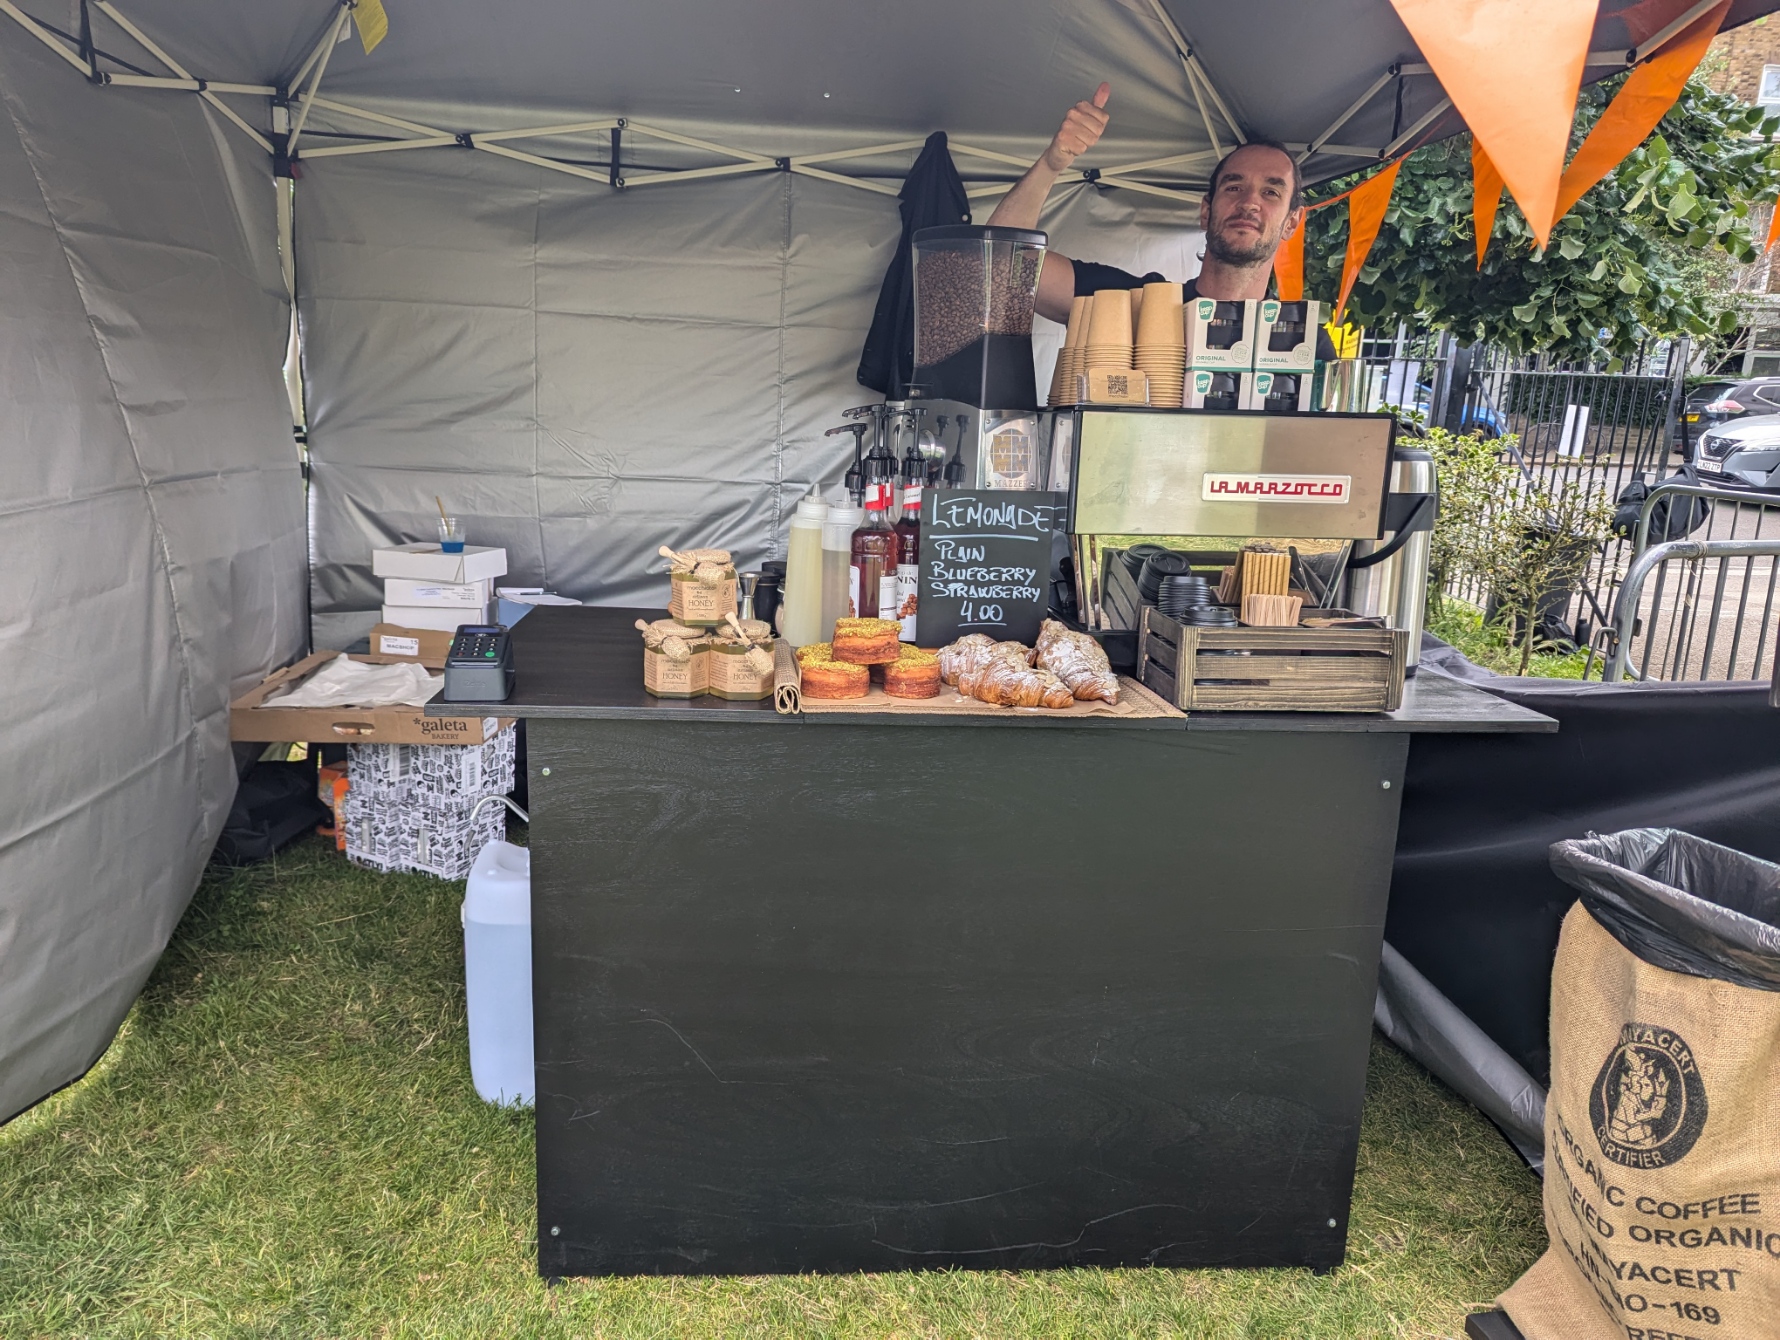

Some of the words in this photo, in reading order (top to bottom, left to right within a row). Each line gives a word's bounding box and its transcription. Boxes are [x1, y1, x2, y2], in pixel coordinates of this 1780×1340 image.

[932, 493, 1050, 532] LEMONADE
[934, 540, 985, 563] PLAIN
[896, 575, 917, 585] NIN
[928, 561, 1037, 586] BLUEBERRY
[688, 599, 714, 607] HONEY
[930, 581, 1041, 603] STRAWBERRY
[960, 600, 1004, 622] 4.00
[662, 672, 688, 680] HONEY
[733, 672, 758, 680] HONEY
[1597, 1125, 1666, 1169] CERTIFIER
[1635, 1192, 1761, 1220] COFFEE
[1628, 1224, 1780, 1260] ORGANIC
